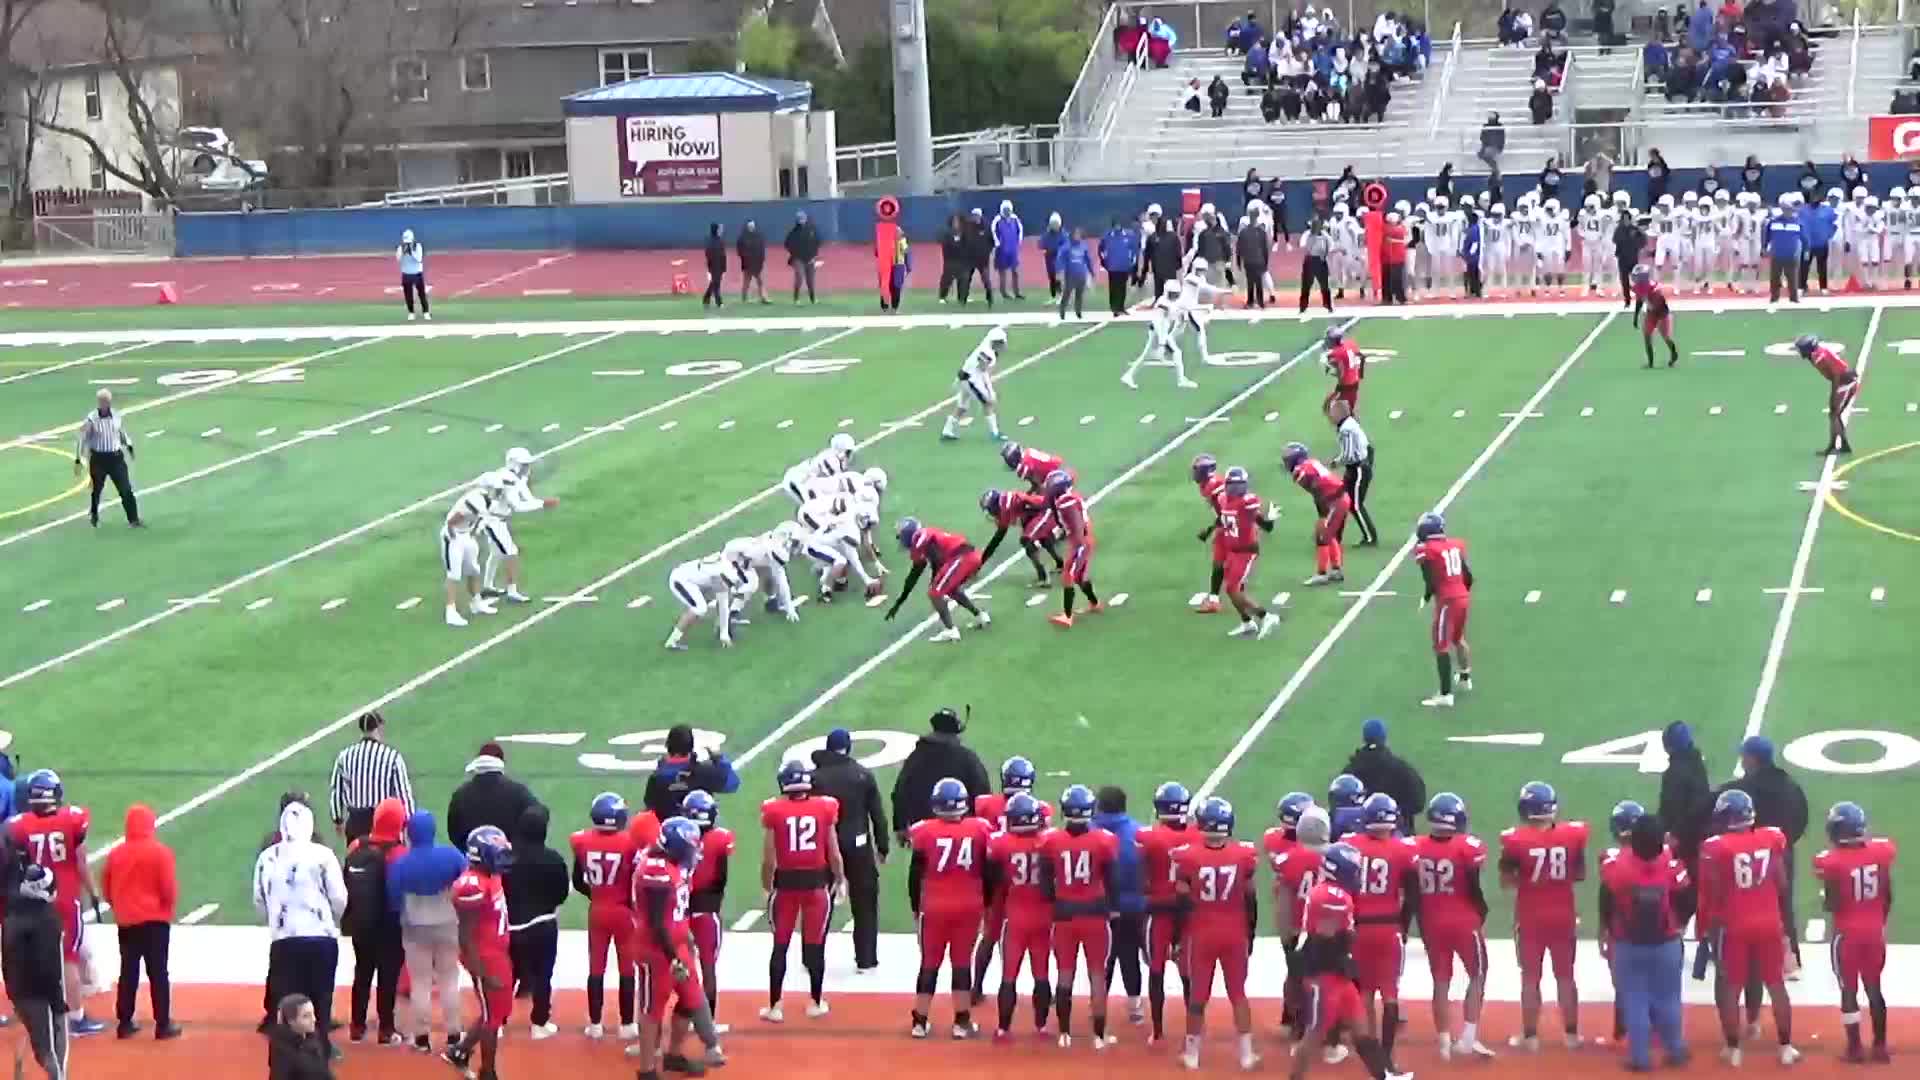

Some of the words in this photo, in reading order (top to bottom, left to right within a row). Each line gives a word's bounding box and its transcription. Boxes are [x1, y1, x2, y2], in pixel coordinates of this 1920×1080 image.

[631, 126, 686, 142] HIRING
[668, 141, 715, 157] NOW!
[1441, 547, 1462, 576] 10
[29, 831, 67, 868] 76
[786, 815, 818, 851] 12
[586, 851, 622, 886] 57
[936, 838, 973, 873] 74
[1060, 850, 1091, 886] 14
[1528, 846, 1566, 883] 78
[1734, 848, 1771, 888] 67
[1198, 864, 1238, 901] 37
[1416, 858, 1455, 894] 62
[1851, 863, 1879, 902] 15
